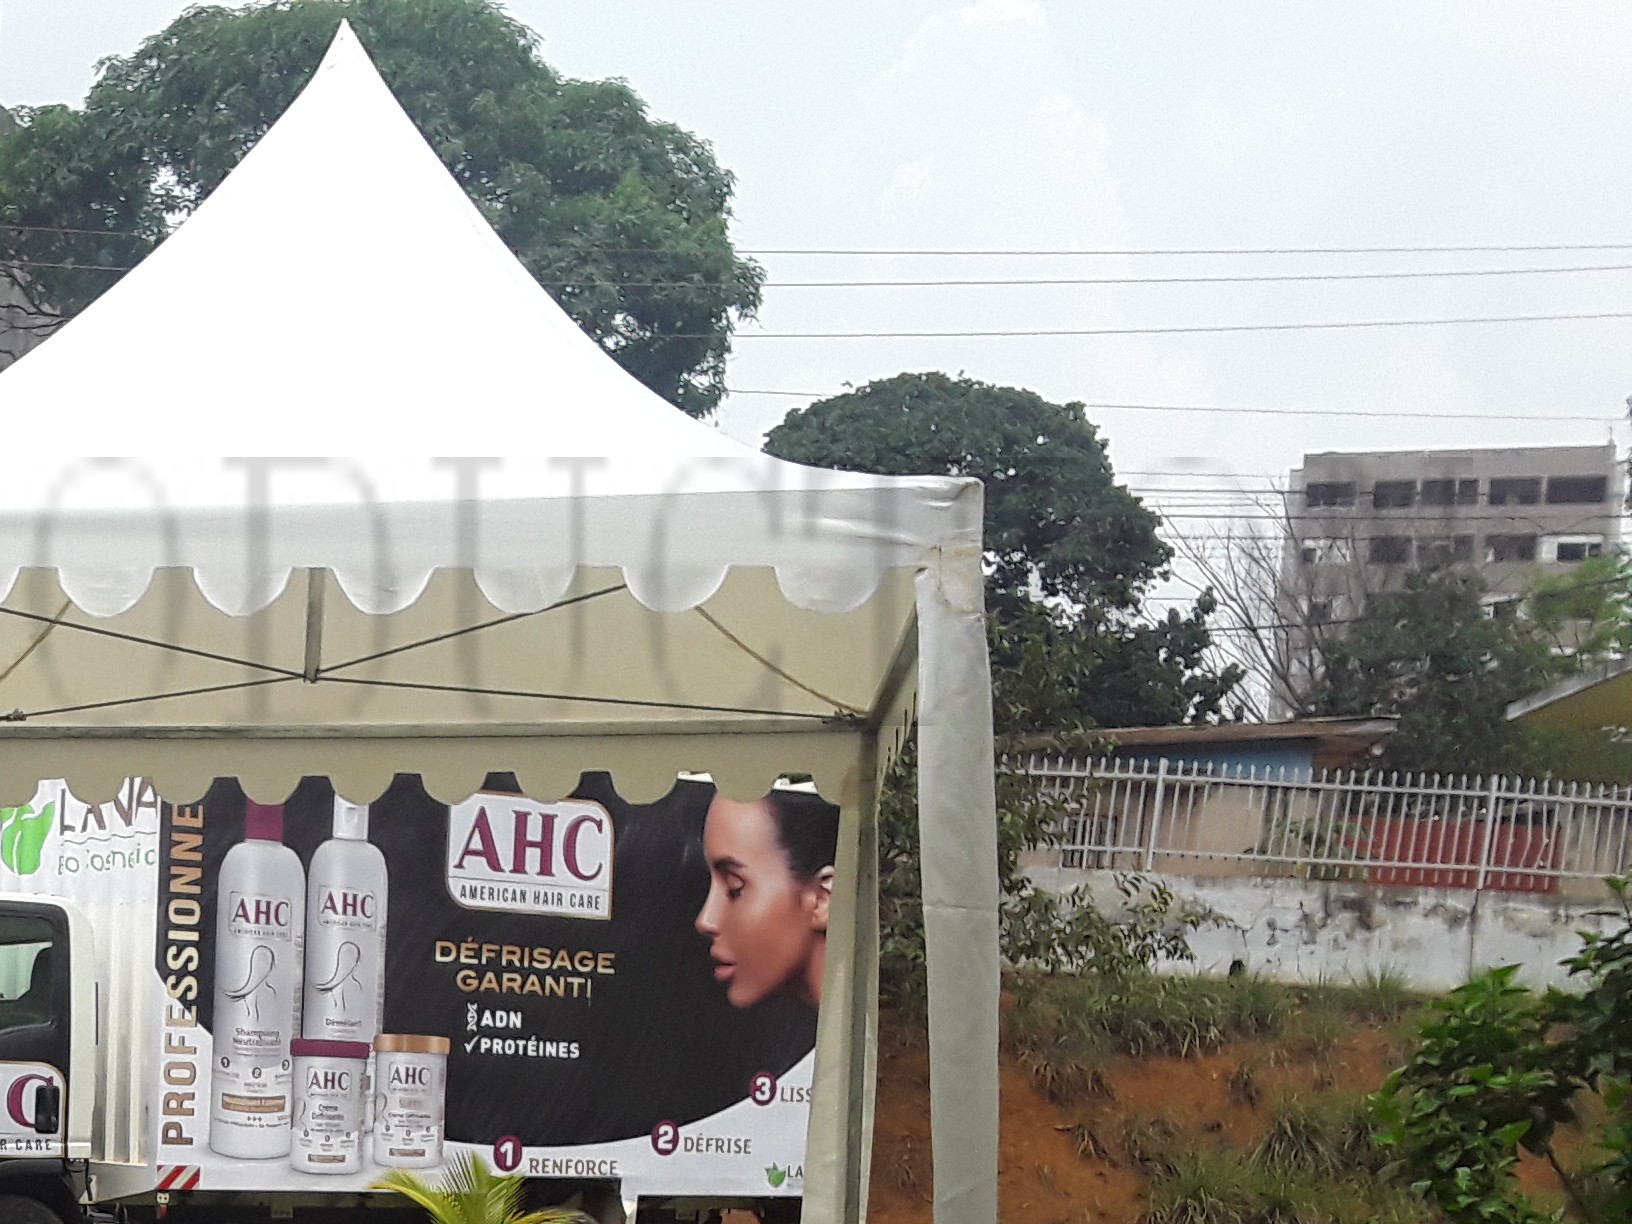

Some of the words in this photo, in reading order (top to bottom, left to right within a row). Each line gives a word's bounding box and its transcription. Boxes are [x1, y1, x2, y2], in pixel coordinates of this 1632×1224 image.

[453, 805, 603, 881] AHC
[321, 890, 374, 918] AHC
[460, 884, 526, 904] AMERICAN
[533, 890, 563, 907] HAIR
[569, 892, 600, 910] CARE
[232, 897, 289, 927] AHC
[434, 937, 616, 974] DÉFRISAGE
[456, 970, 592, 999] GARANTI
[481, 1010, 522, 1029] ADN
[481, 1035, 580, 1059] PROTÉINES
[308, 1071, 350, 1091] AHC
[390, 1066, 430, 1085] AHC
[755, 1076, 771, 1101] 3
[780, 1086, 812, 1103] LISS
[16, 1138, 53, 1151] CARE
[657, 1125, 674, 1150] 2
[683, 1133, 752, 1154] DÉFRISE
[529, 1157, 618, 1175] RENFORCE
[788, 1164, 803, 1178] LA
